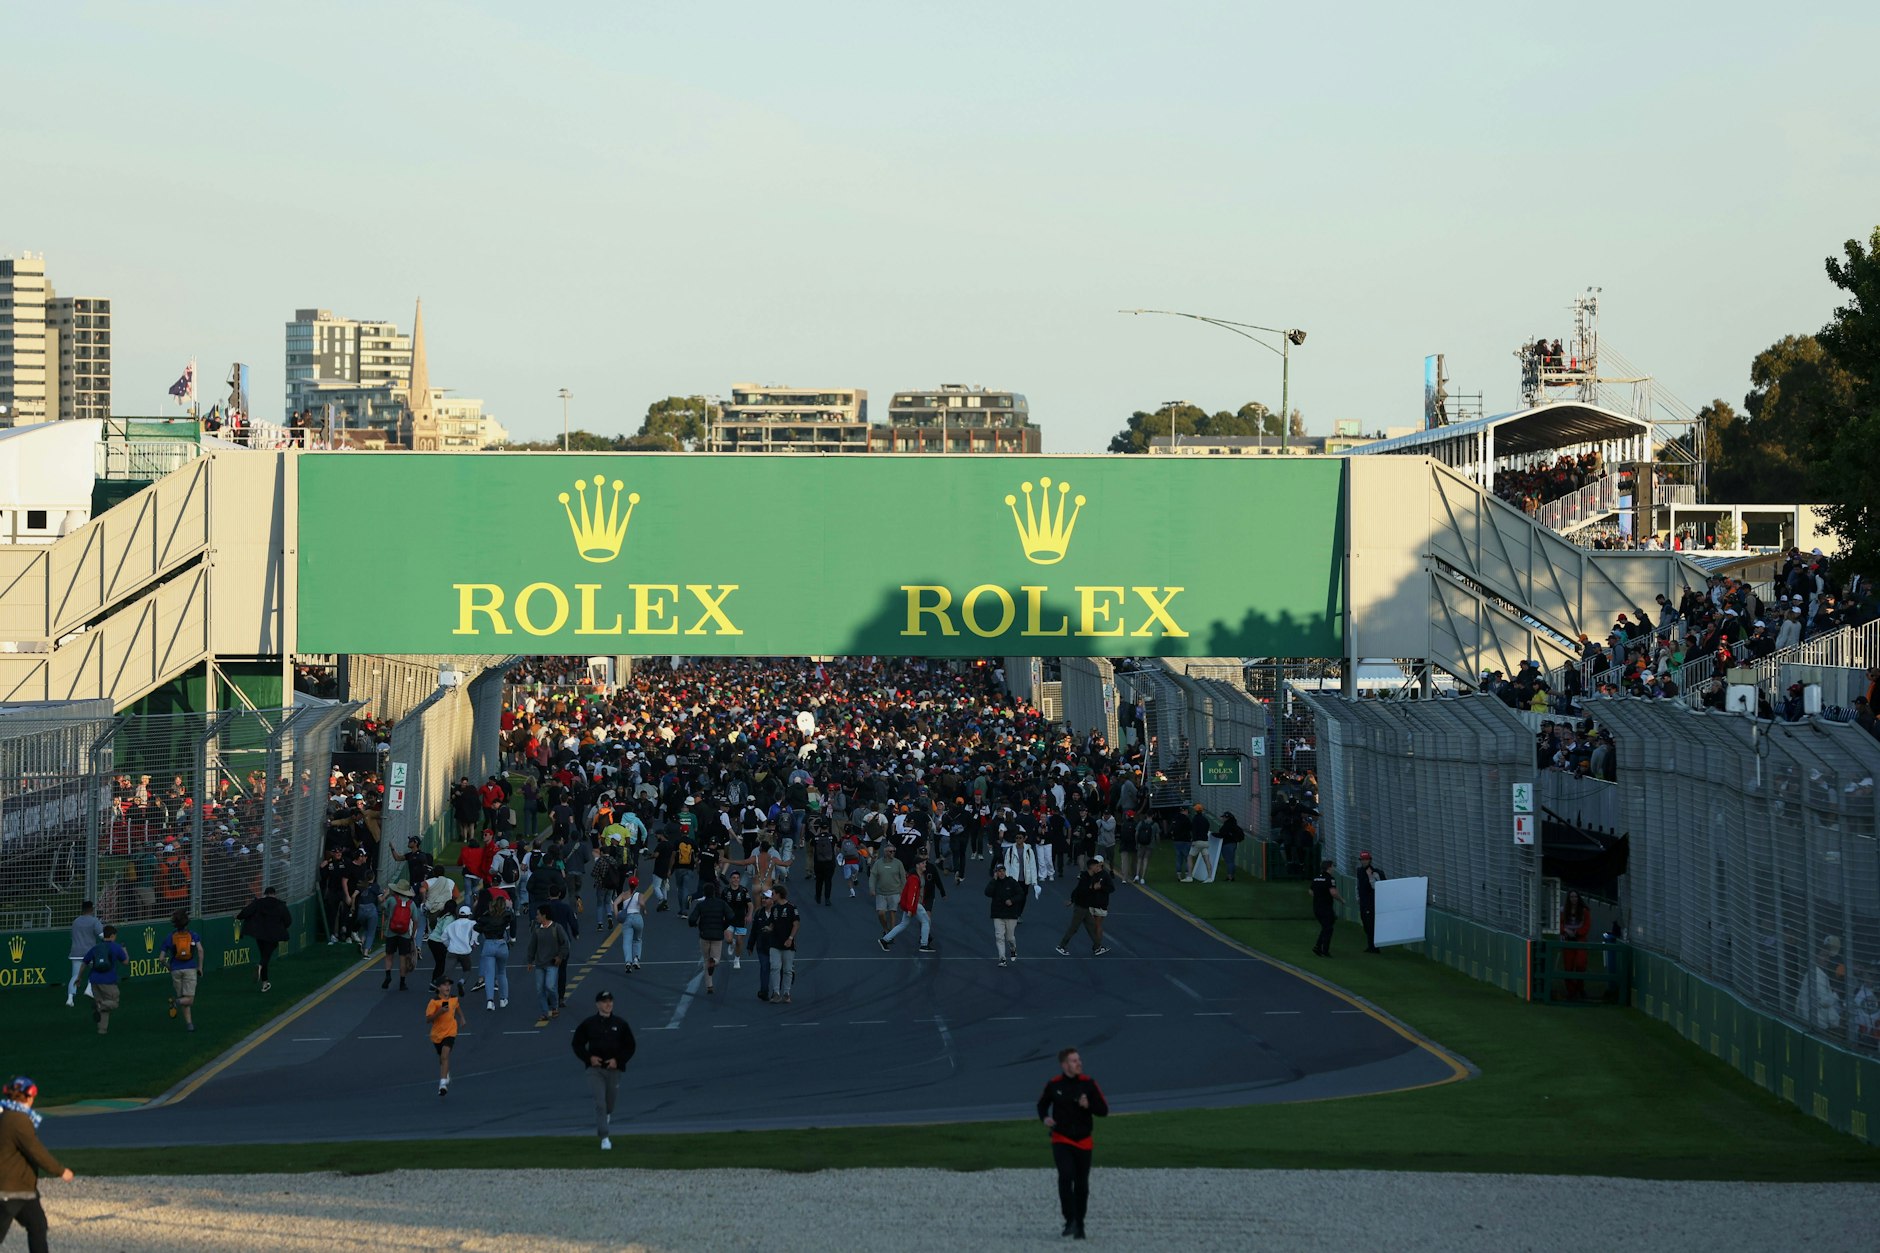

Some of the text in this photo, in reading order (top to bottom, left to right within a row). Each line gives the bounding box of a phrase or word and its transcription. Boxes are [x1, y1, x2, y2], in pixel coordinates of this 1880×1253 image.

[452, 582, 744, 637] ROLEX
[901, 584, 1189, 638] ROLEX
[129, 956, 170, 977] ROLEX
[223, 947, 250, 967] ROLEX
[0, 967, 47, 987] OLEX
